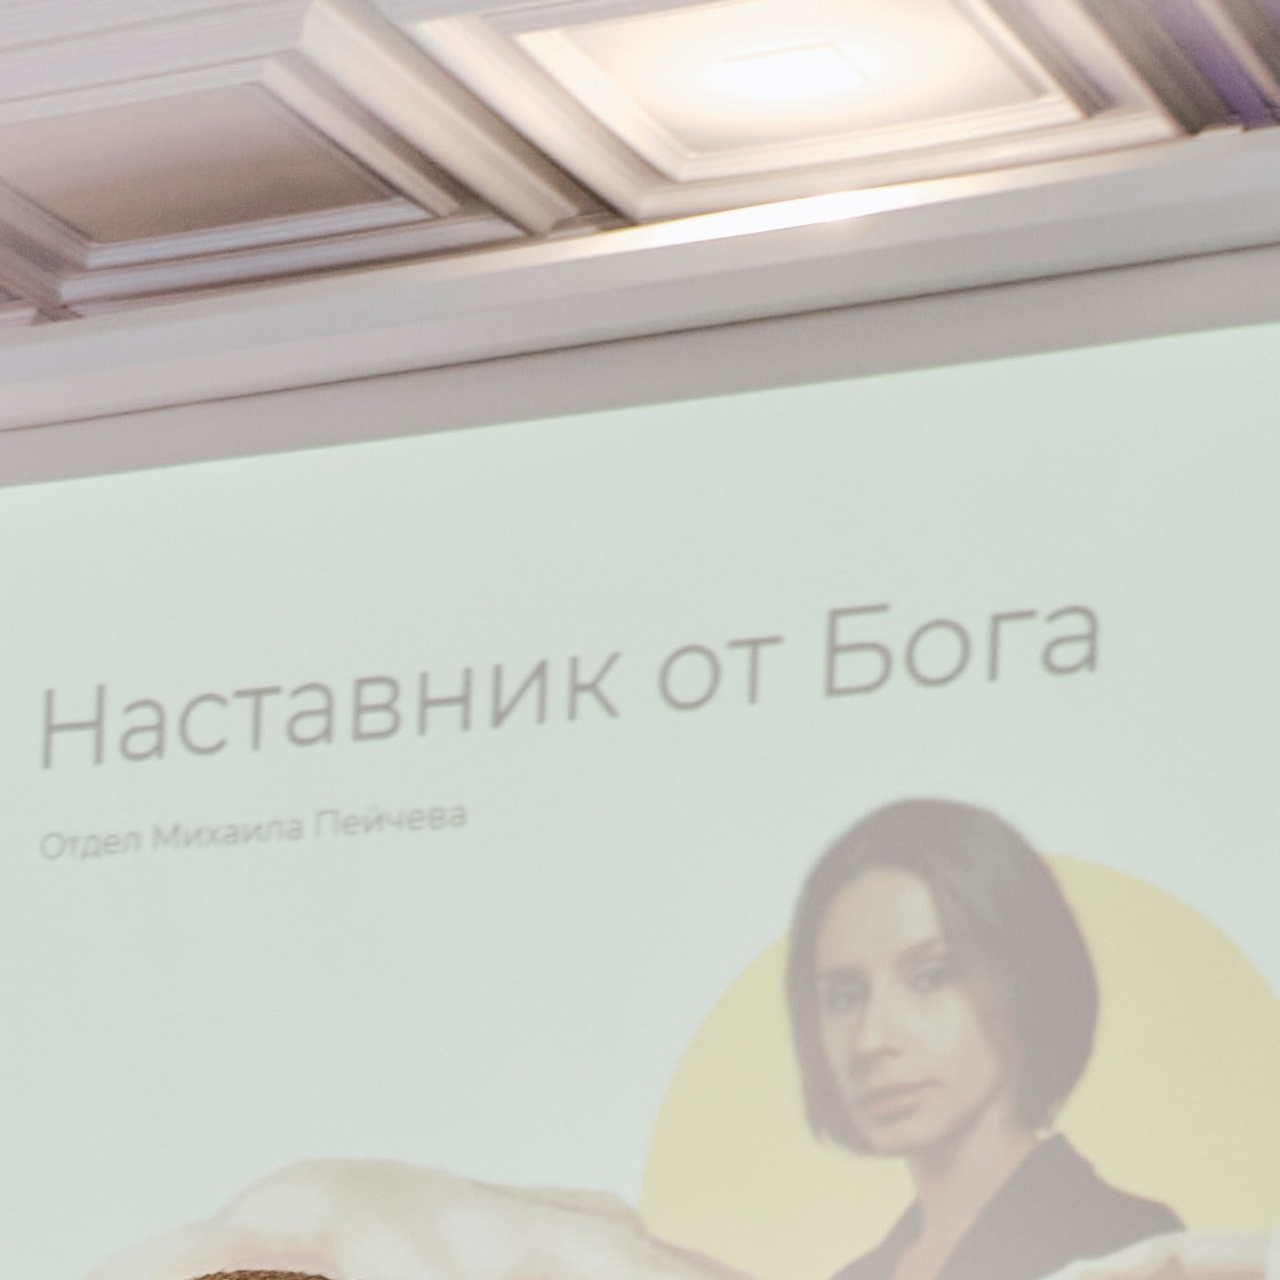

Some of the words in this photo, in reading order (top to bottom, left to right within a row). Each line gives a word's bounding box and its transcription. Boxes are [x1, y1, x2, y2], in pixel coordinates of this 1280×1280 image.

[41, 651, 623, 771] Наставник
[657, 634, 785, 713] от
[822, 602, 1100, 699] Бога
[38, 830, 143, 862] Отдел
[151, 817, 305, 850] Михаила
[314, 802, 468, 837] Пейчева
